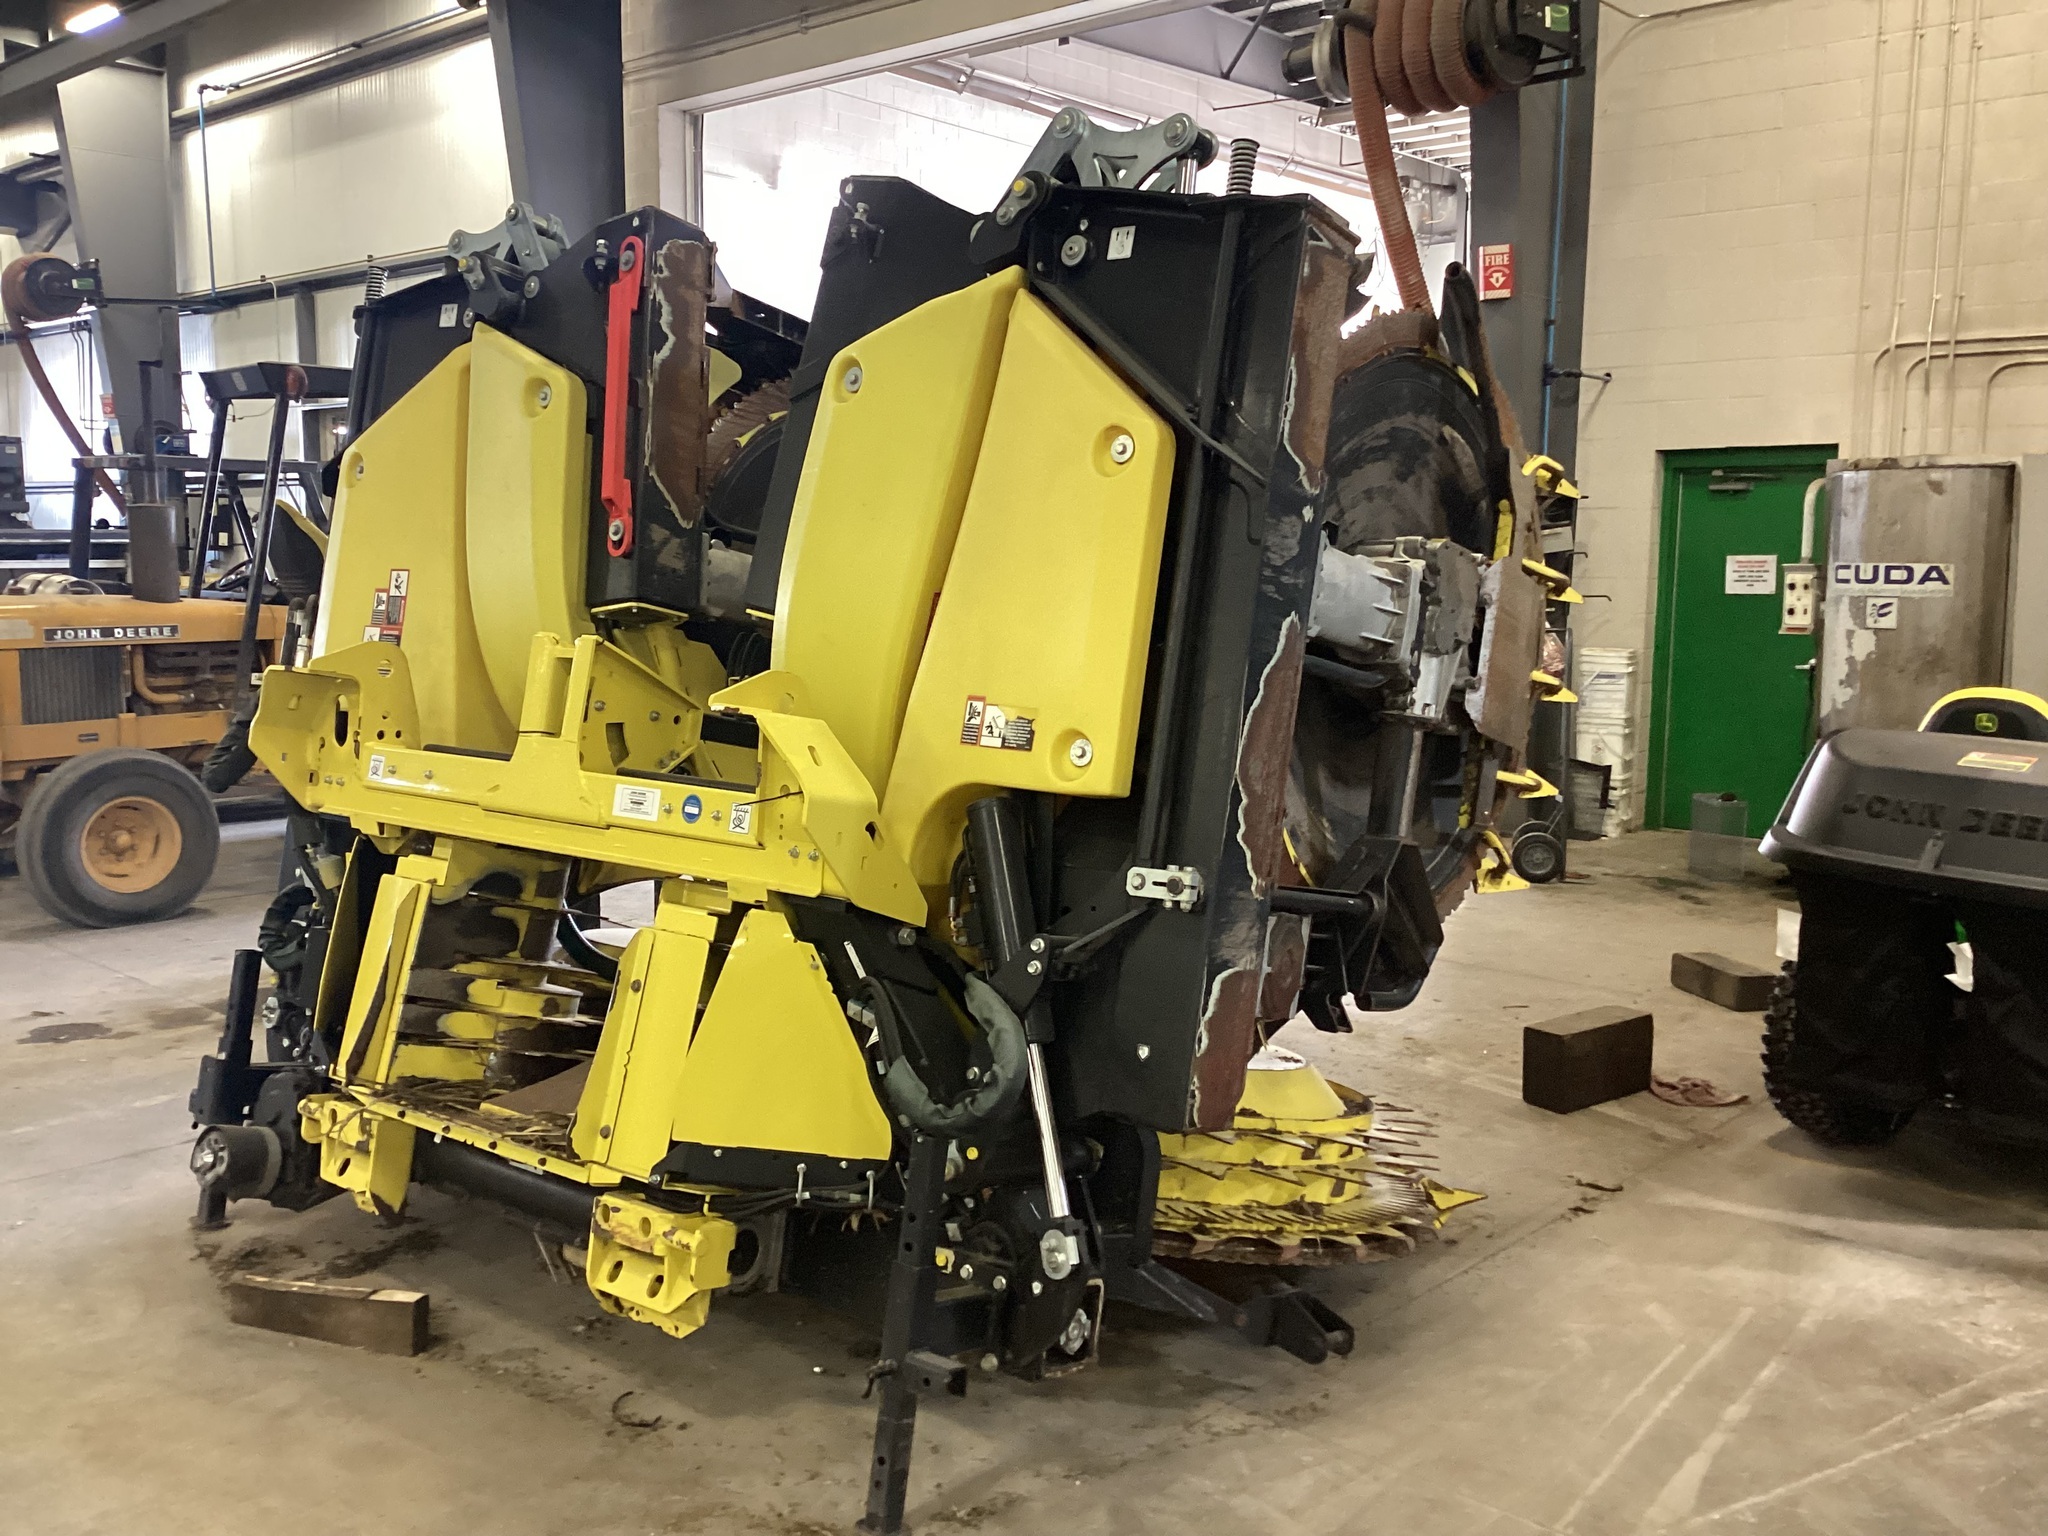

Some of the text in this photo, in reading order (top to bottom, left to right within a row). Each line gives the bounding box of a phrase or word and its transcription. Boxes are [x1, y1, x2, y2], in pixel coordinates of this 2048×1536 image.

[1485, 254, 1510, 266] FIRE
[1835, 564, 1950, 585] CUDA
[53, 626, 172, 640] JOHN DEERE
